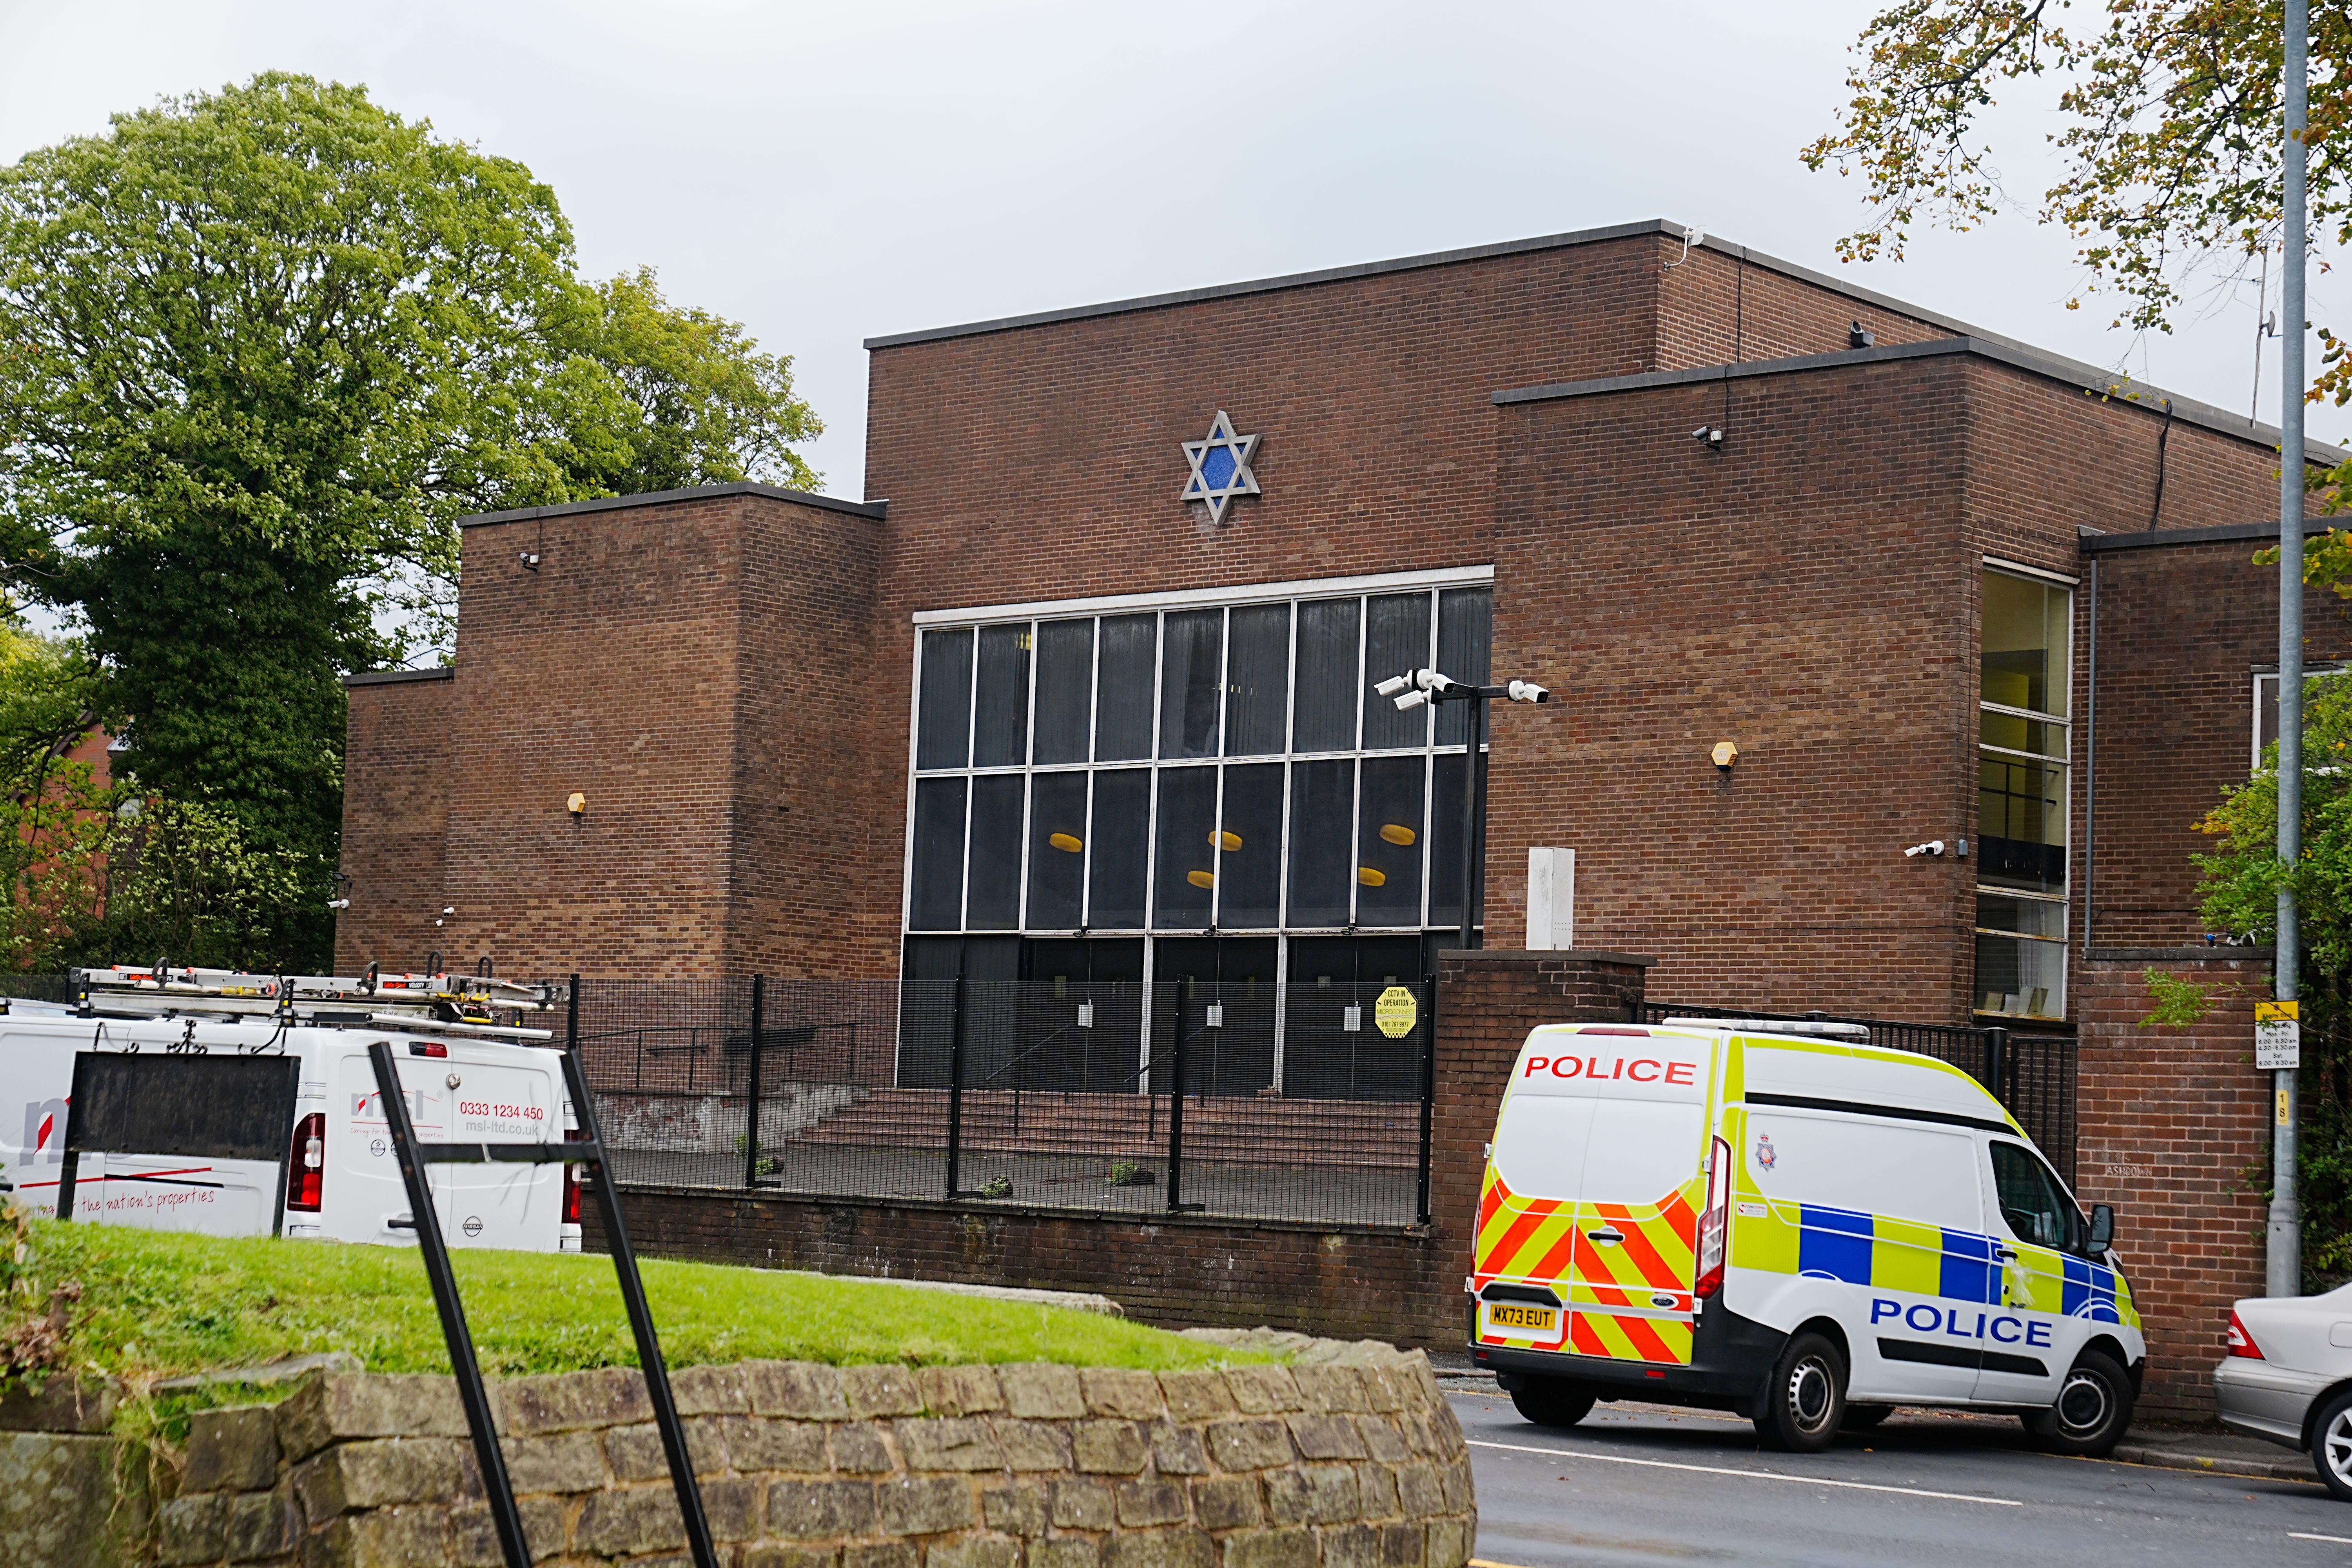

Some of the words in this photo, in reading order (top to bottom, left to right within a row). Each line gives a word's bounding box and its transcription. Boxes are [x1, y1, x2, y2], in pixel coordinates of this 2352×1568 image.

[1524, 1056, 1697, 1085] POLICE
[460, 1102, 489, 1116] 0333
[494, 1104, 520, 1118] 1234
[523, 1107, 543, 1120] 450
[350, 1127, 369, 1137] Caring
[466, 1120, 537, 1136] msl-ltd.co.uk
[2107, 1165, 2152, 1176] ASHDOWN
[82, 1196, 101, 1212] the
[106, 1191, 152, 1210] nation's
[157, 1186, 214, 1213] properties
[1494, 1307, 1523, 1324] MX73
[1526, 1310, 1550, 1327] EUT
[1871, 1299, 2052, 1348] POLICE
